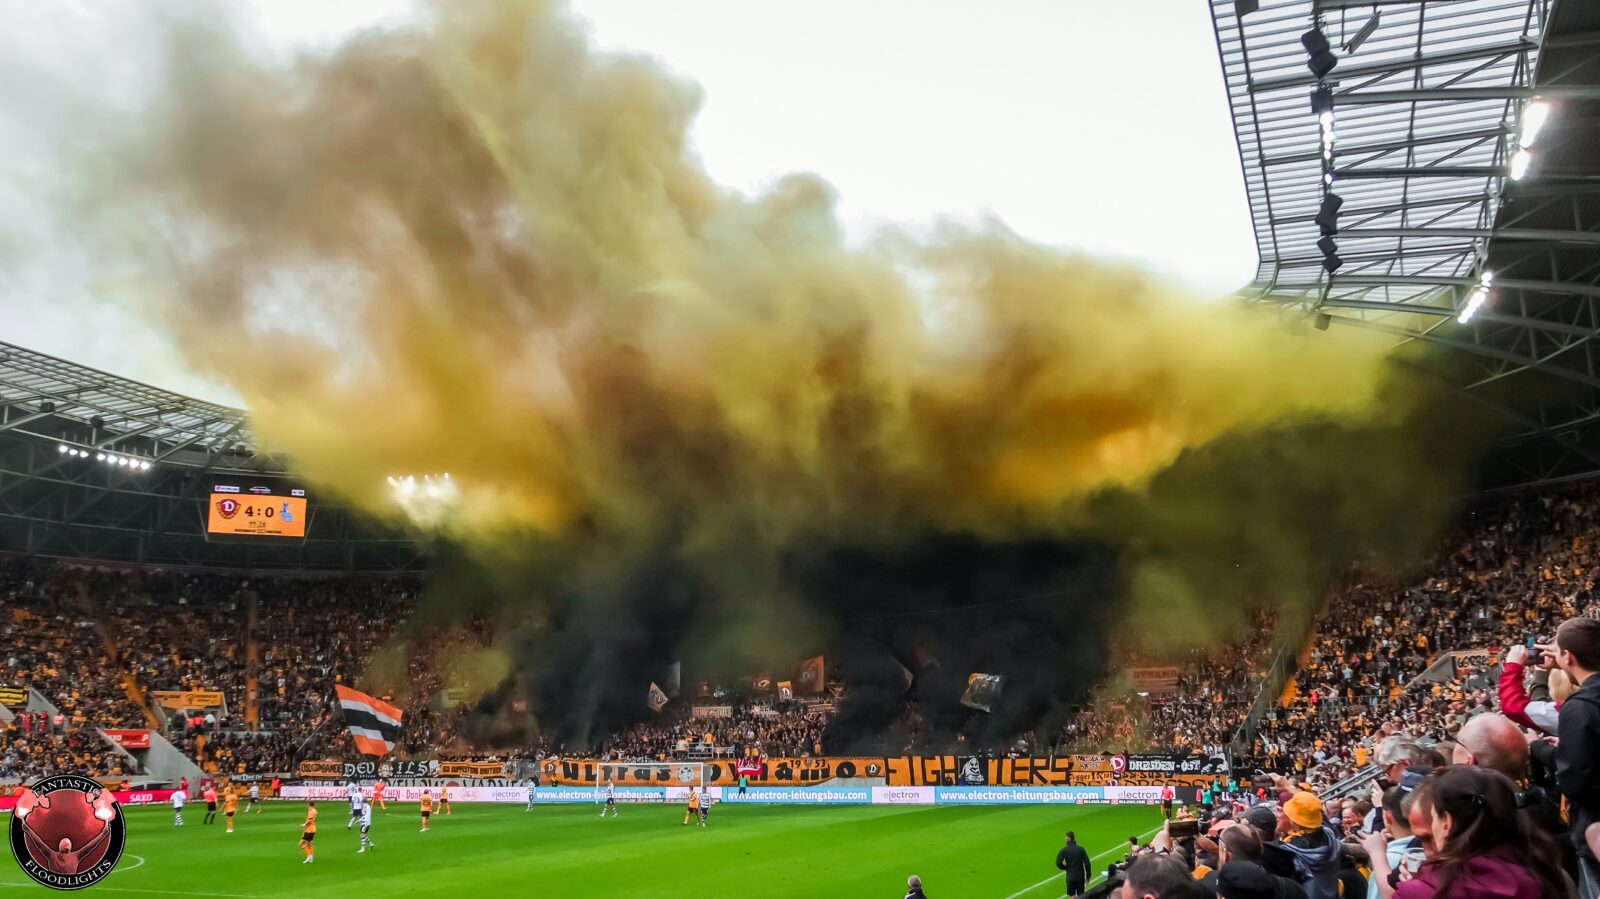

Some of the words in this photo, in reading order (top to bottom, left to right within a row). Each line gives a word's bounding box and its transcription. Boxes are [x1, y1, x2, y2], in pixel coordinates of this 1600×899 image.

[790, 760, 801, 769] 19
[815, 759, 826, 768] 53
[129, 793, 153, 802] SAXO
[884, 790, 920, 801] electron
[940, 789, 1099, 801] www.electron-leitungsbau.com
[1117, 789, 1158, 800] electron
